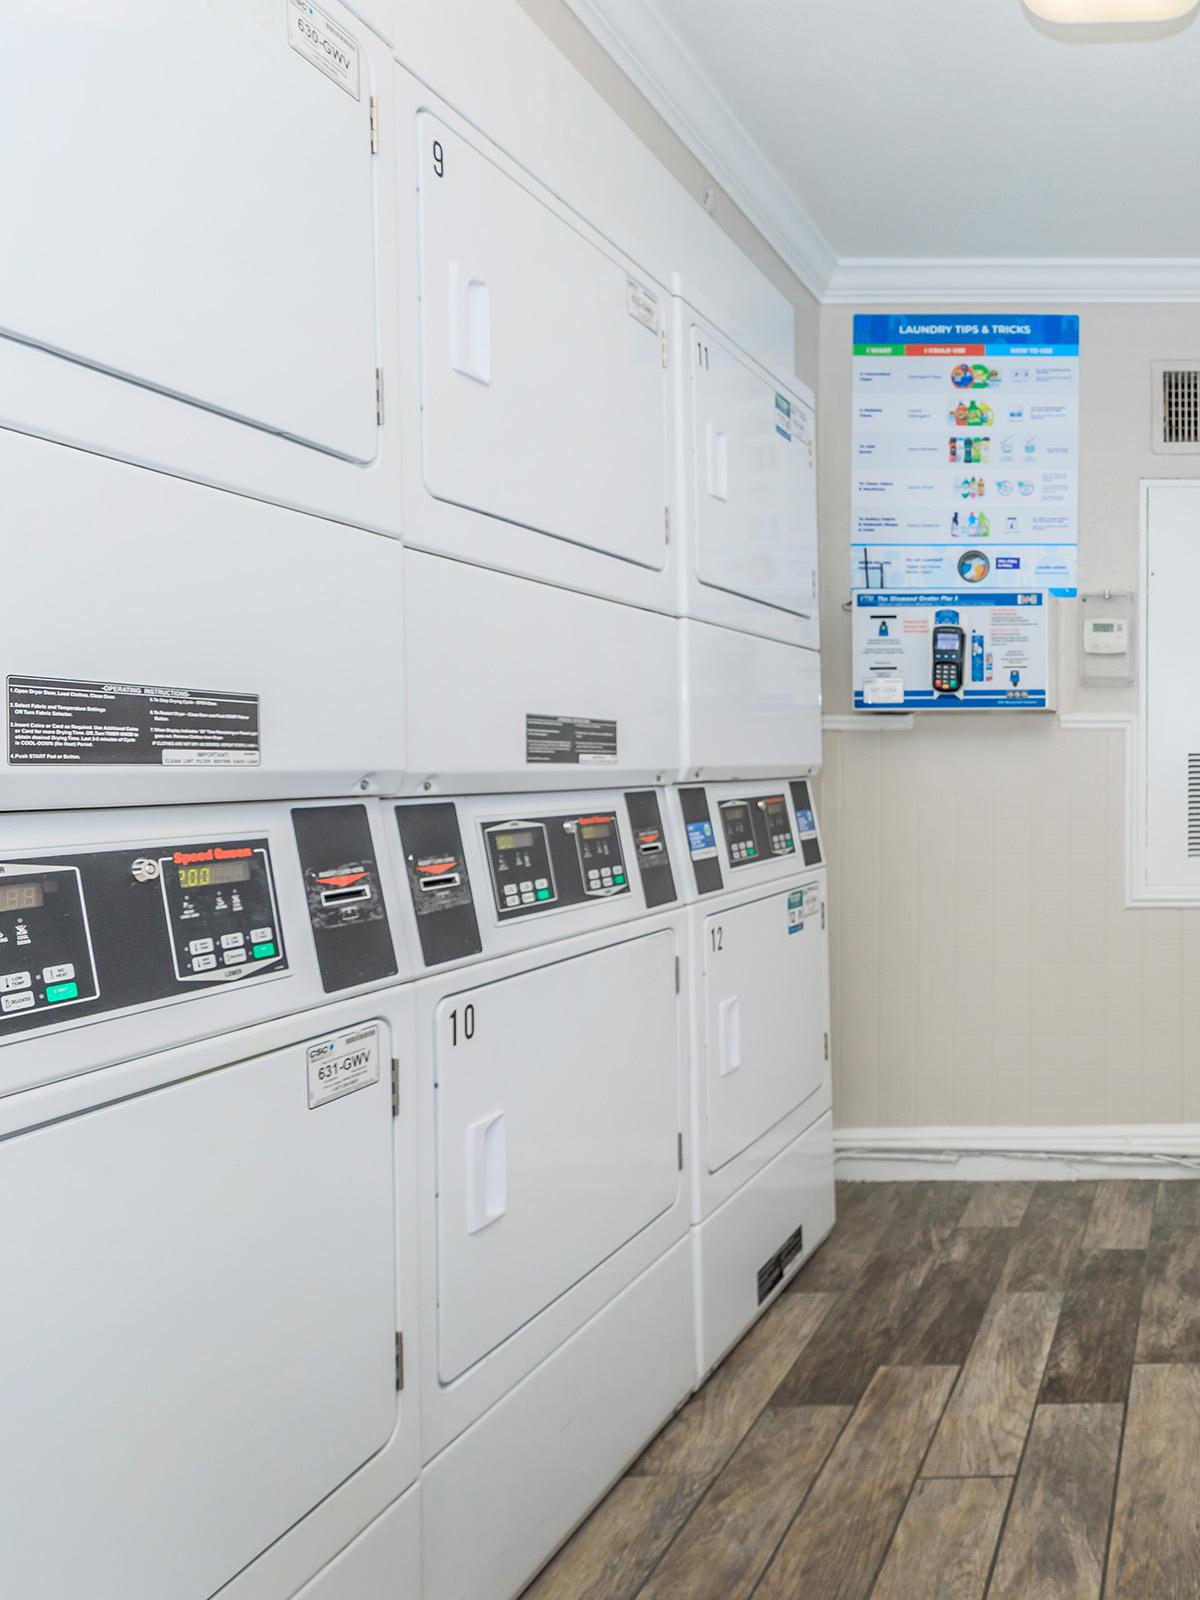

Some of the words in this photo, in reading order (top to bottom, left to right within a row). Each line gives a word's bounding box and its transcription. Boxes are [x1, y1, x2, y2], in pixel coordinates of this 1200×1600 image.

[297, 18, 351, 69] 630-GWV
[433, 140, 444, 178] 9
[899, 325, 952, 335] LAUNDRY
[955, 325, 979, 335] TIPS
[980, 325, 990, 335] &
[992, 325, 1032, 336] TRICKS
[698, 342, 709, 371] 11
[173, 849, 215, 865] Speed
[213, 848, 254, 861] Queen
[711, 926, 723, 952] 12
[450, 1004, 474, 1046] 10
[309, 1046, 328, 1058] CSC
[318, 1050, 371, 1080] 631-GWV
